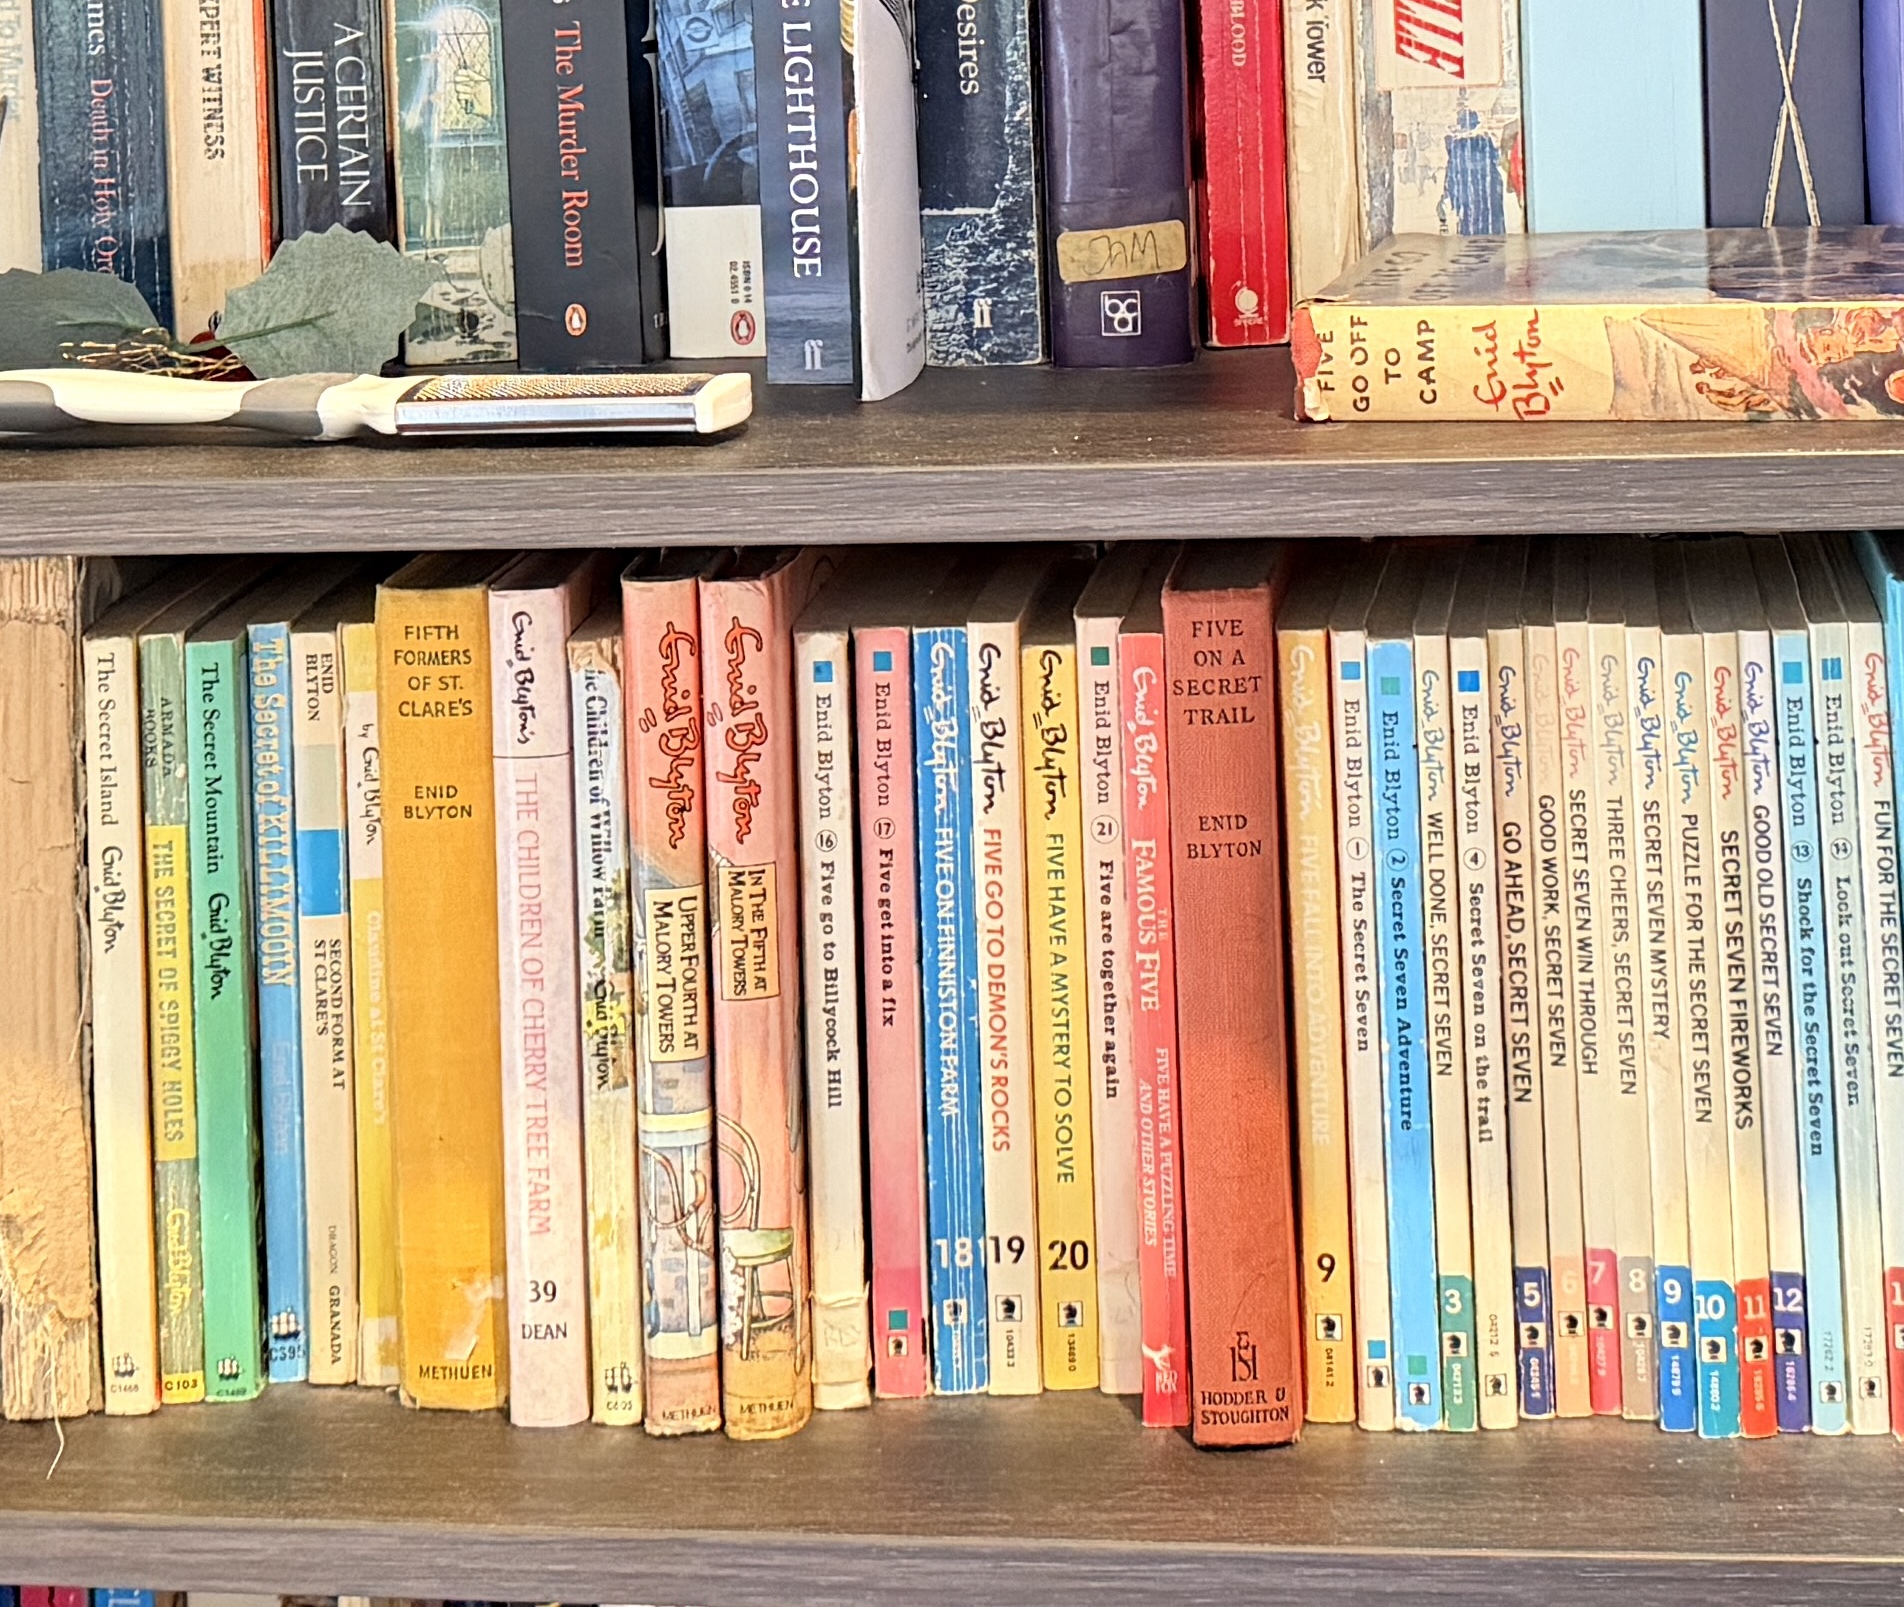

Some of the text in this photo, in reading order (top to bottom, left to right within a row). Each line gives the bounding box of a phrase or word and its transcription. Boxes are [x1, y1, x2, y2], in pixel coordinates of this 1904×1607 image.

[554, 21, 582, 75] The
[557, 84, 588, 180] Murder
[783, 21, 822, 278] LIGHTHOUSE
[561, 189, 588, 268] Room
[1317, 330, 1334, 393] FIVE
[1351, 314, 1370, 412] GO OFF
[1384, 346, 1400, 384] TO
[1419, 319, 1437, 405] CAMP
[1472, 320, 1507, 412] Enid
[1513, 308, 1552, 420] Blyton
[404, 625, 459, 641] FIFTH
[1191, 619, 1243, 638] FIVE
[394, 649, 472, 665] FORMERS
[1194, 649, 1246, 666] ON A
[407, 674, 464, 691] OF ST.
[1173, 675, 1262, 696] SECRET
[398, 699, 472, 718] CLARE'S
[1184, 707, 1256, 726] TRAIL
[98, 653, 125, 953] The Secret Island Enid Blyton
[414, 785, 458, 800] ENID
[403, 804, 472, 820] BLYTON
[1198, 814, 1248, 832] ENID
[1187, 840, 1262, 860] BLYTON
[984, 829, 1010, 1152] FIVE GO TO DEMON'S ROCKS
[989, 1235, 1026, 1265] 19
[1048, 1239, 1089, 1271] 20
[529, 1280, 557, 1304] 39
[521, 1321, 567, 1340] DEAN
[419, 1364, 493, 1380] METHUEN
[1201, 1389, 1268, 1407] HODDER
[1201, 1406, 1289, 1425] STOUGHTON
